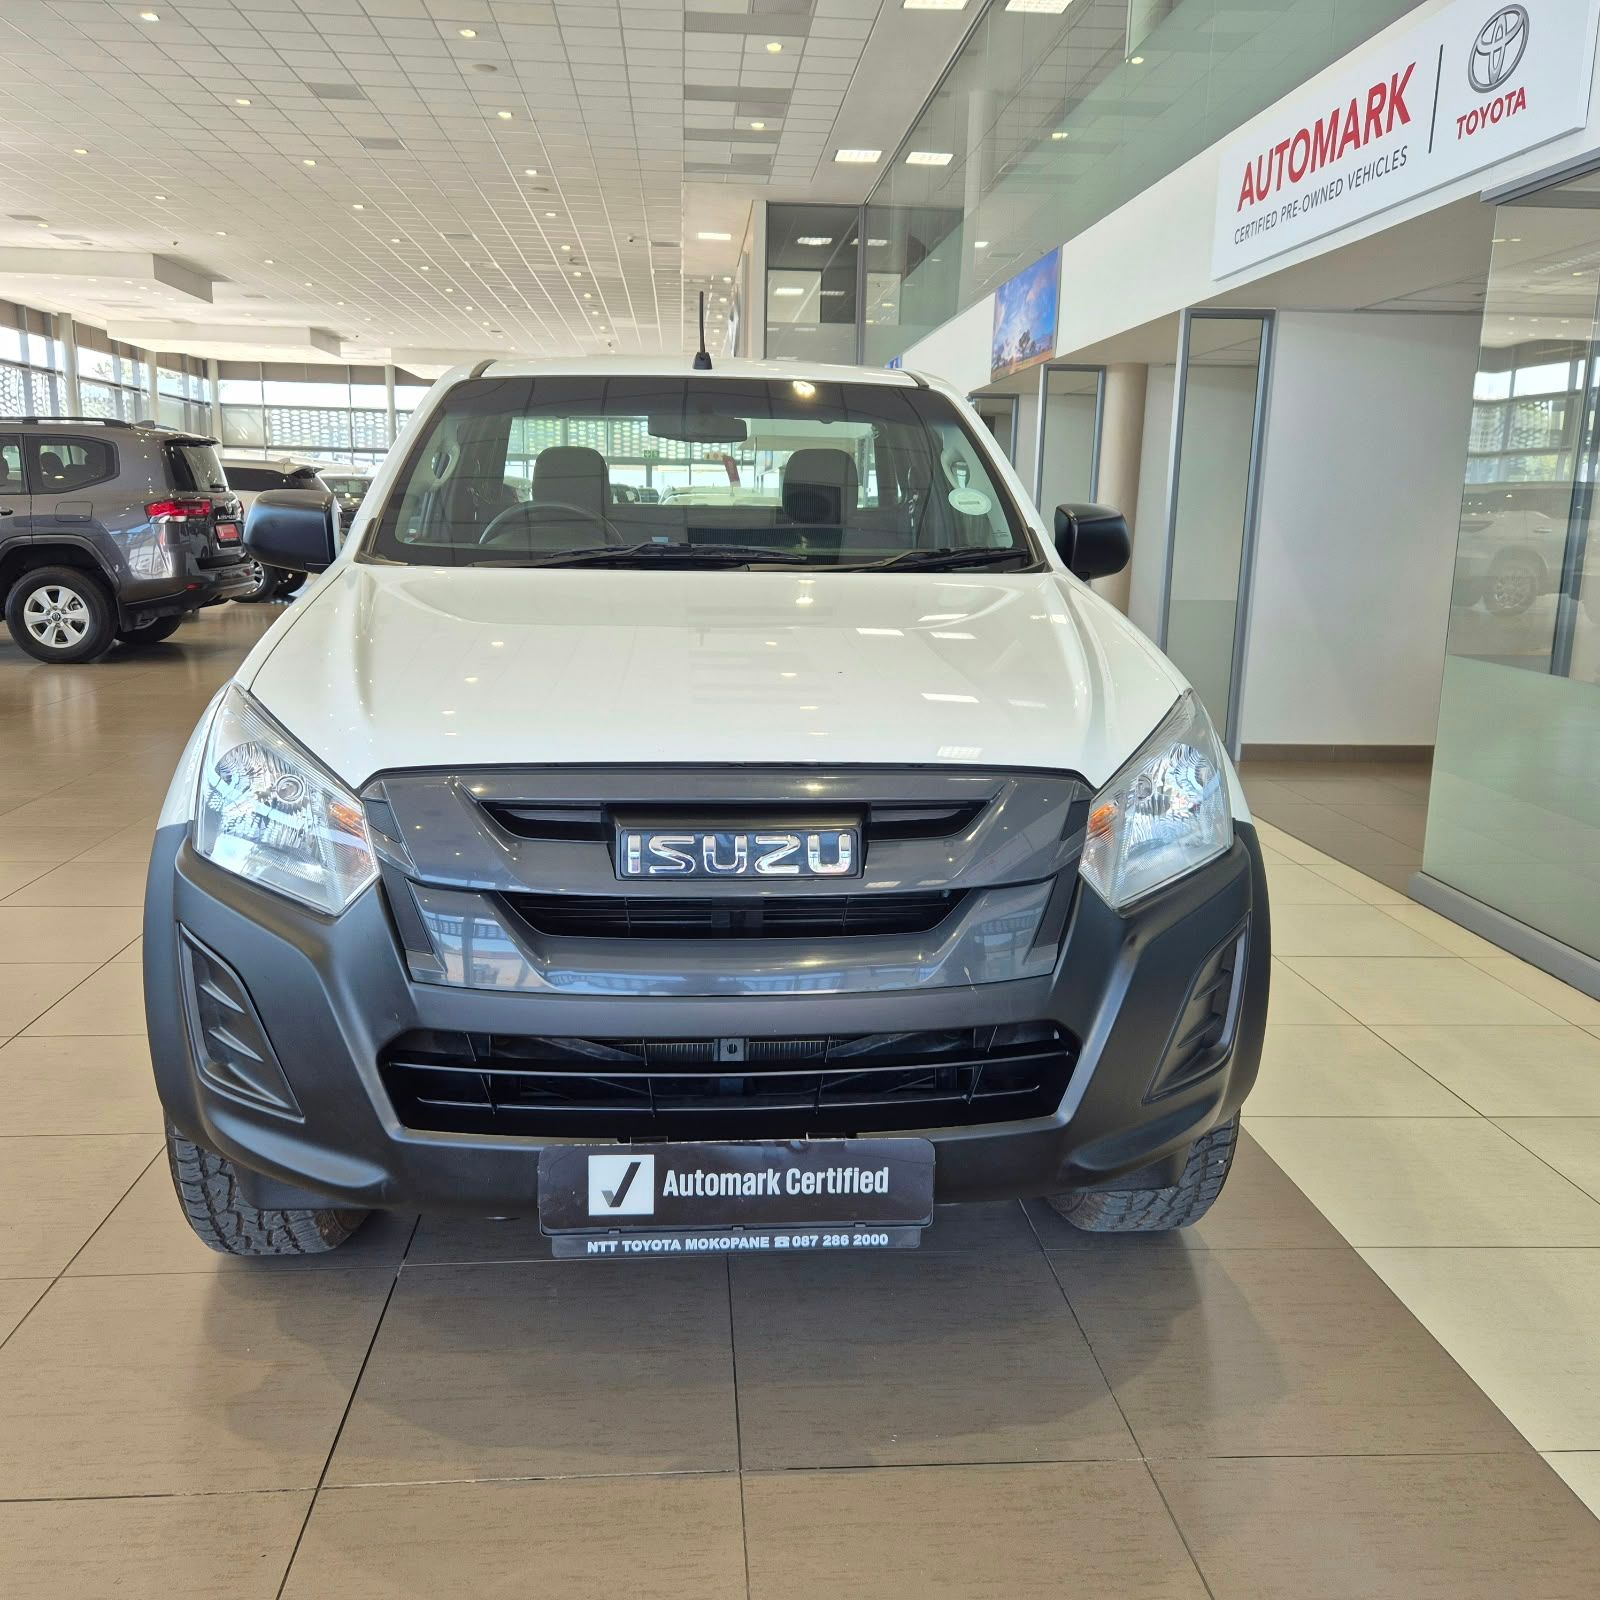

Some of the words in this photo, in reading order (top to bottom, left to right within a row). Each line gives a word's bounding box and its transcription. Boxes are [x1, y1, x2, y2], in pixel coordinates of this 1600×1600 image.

[1456, 86, 1527, 140] TOYOTA
[1237, 62, 1416, 213] AUTOMARK
[1234, 210, 1278, 245] CERTIFIED
[1280, 178, 1344, 223] PRE-OWNED
[1347, 145, 1408, 191] VEHICLES
[627, 834, 851, 874] ISUZU
[662, 1168, 781, 1197] Automark
[785, 1166, 889, 1195] Certified
[587, 1240, 619, 1254] NTT
[621, 1239, 682, 1252] TOYOTA
[685, 1236, 770, 1250] MOKOPANE
[791, 1235, 819, 1248] 087
[822, 1234, 850, 1247] 286
[853, 1233, 889, 1246] 2000
